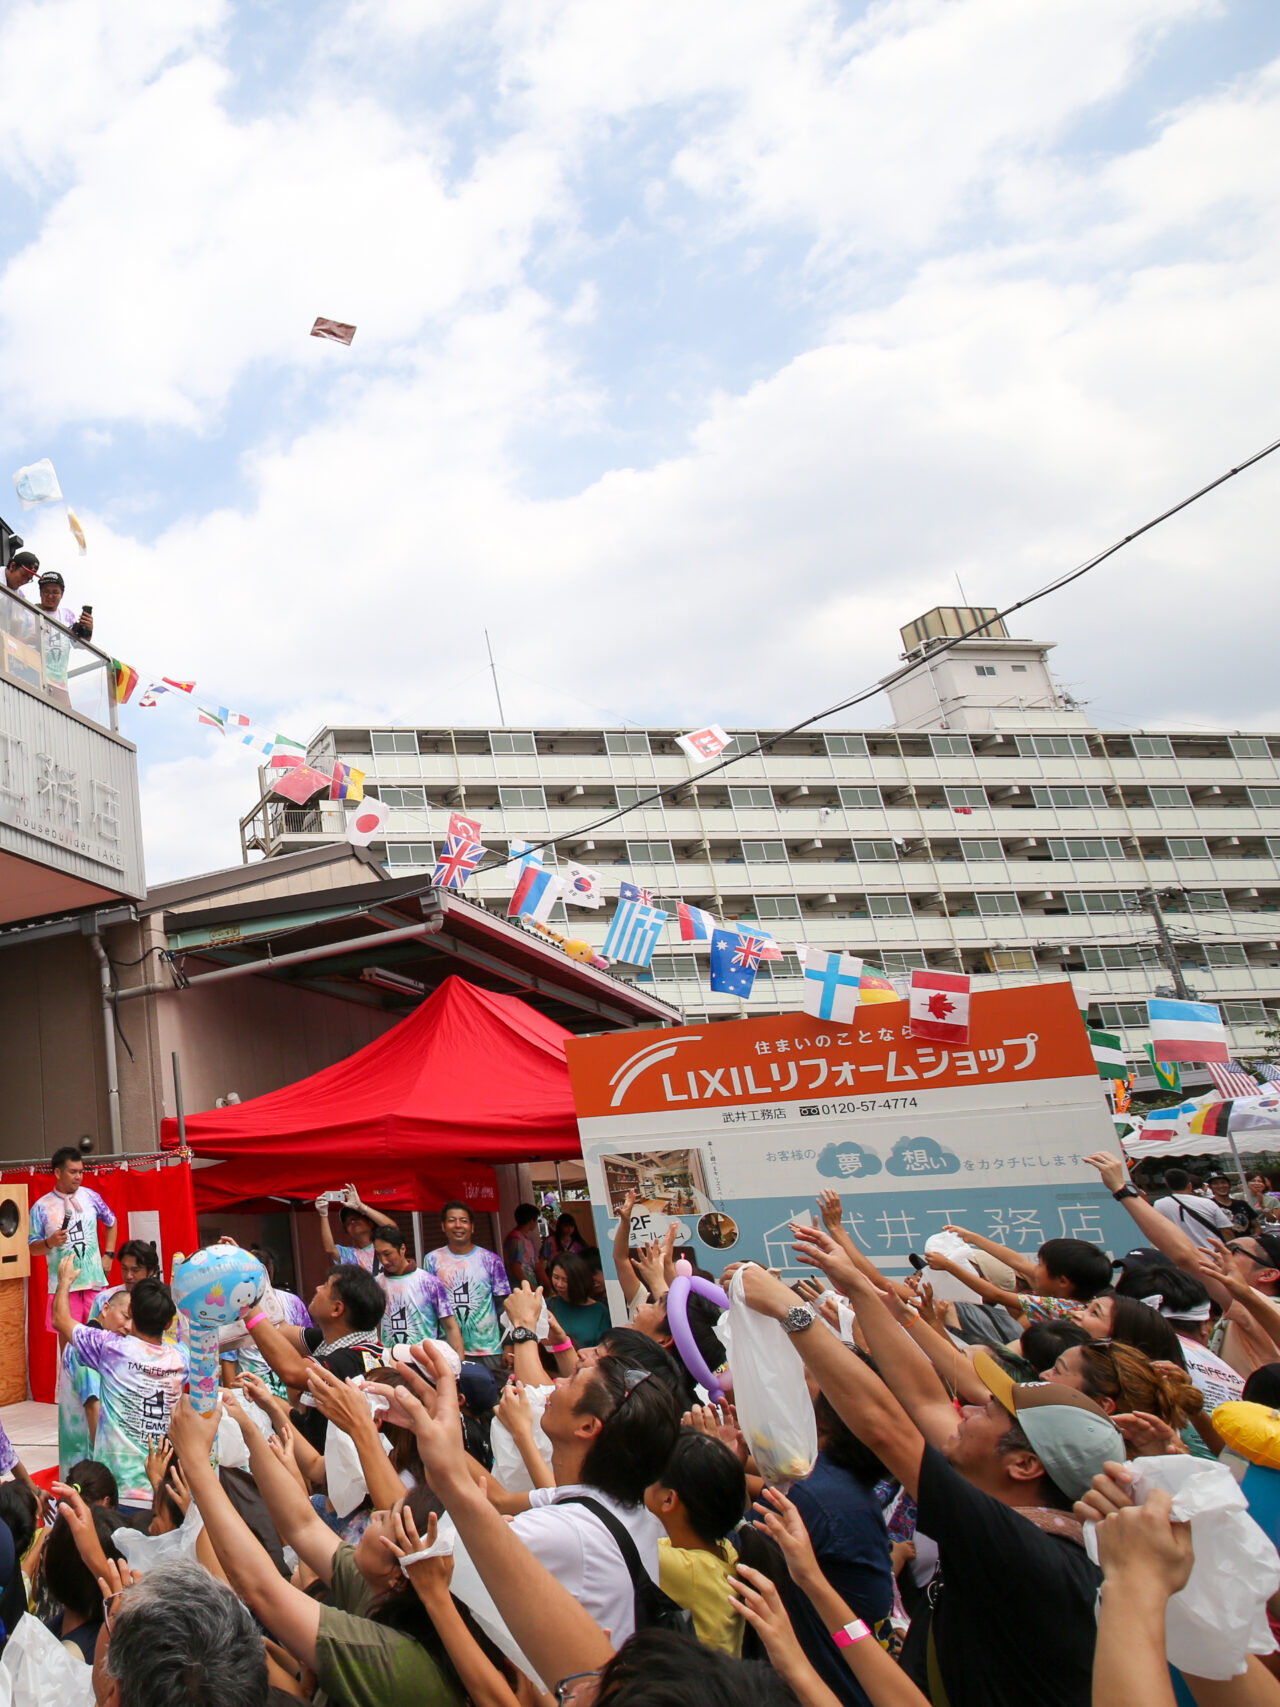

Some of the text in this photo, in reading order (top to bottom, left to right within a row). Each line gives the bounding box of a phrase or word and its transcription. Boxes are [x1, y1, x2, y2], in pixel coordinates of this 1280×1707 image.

[754, 1024, 915, 1056] 住まいのことなら
[662, 1033, 1039, 1101] LIXILリフォームショップ
[722, 1097, 918, 1123] 武井工務店 0120-57-4774
[766, 1149, 1086, 1175] お客様の 夢 想い をカタチにします
[140, 1419, 166, 1432] TEAM
[140, 1431, 166, 1443] TAKE
